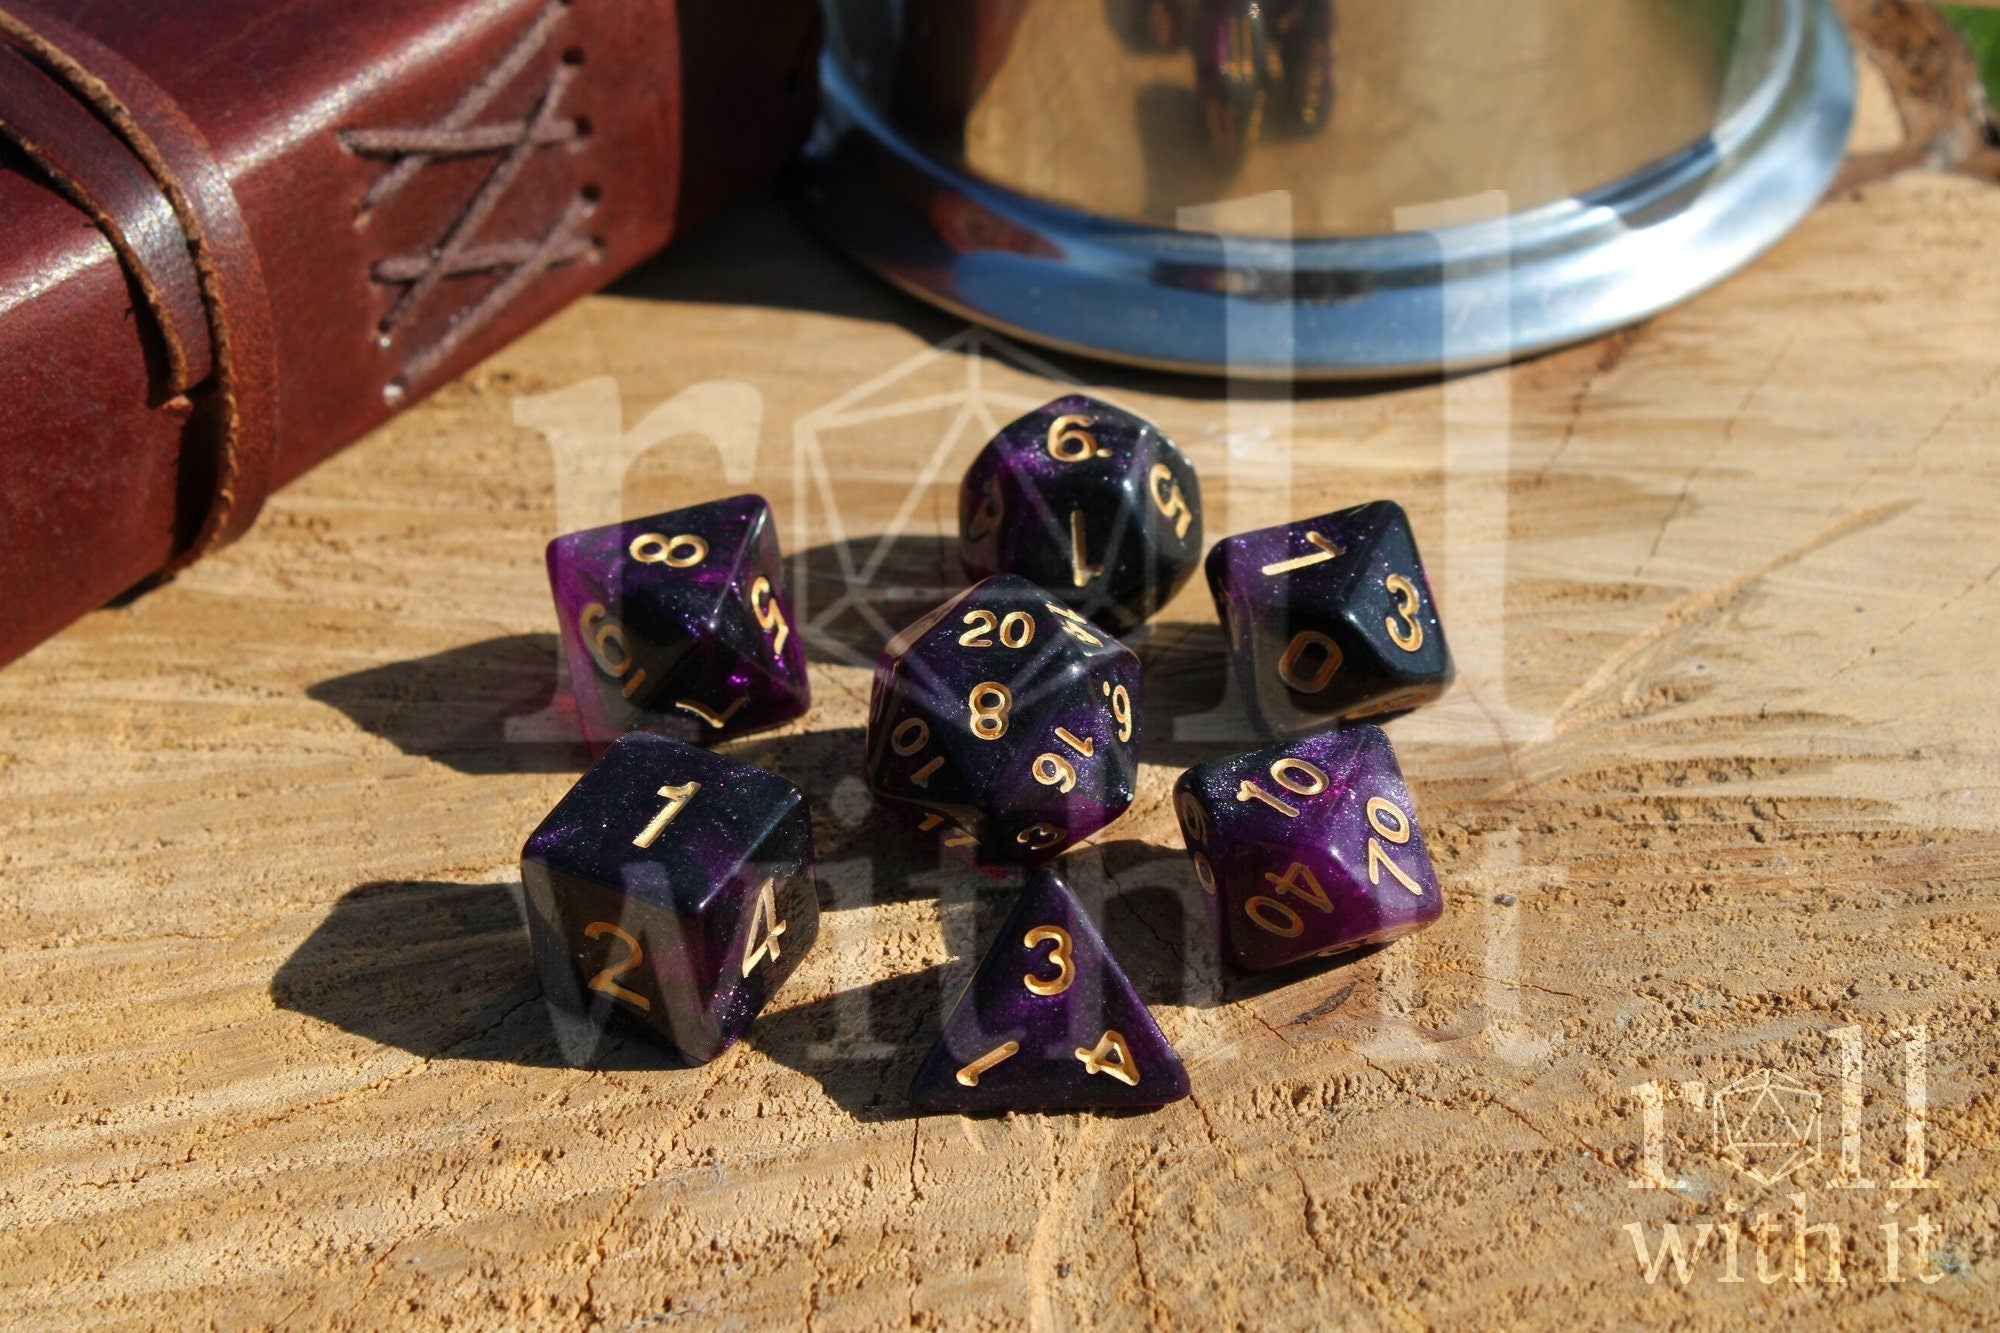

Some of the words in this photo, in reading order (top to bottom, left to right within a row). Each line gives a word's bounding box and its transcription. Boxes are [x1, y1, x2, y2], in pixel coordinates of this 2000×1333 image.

[1150, 463, 1193, 539] 5
[629, 533, 709, 568] 8
[1069, 509, 1103, 588] 1
[751, 576, 790, 655] 5
[958, 609, 1036, 649] 20
[1385, 573, 1424, 652] 3
[1278, 630, 1343, 694] 0
[969, 681, 1013, 740] 8
[891, 717, 945, 789] 10
[1032, 726, 1094, 793] 16
[1236, 757, 1330, 818] 10
[632, 780, 702, 849] 1
[1366, 796, 1424, 895] 70
[742, 877, 788, 979] 4
[1244, 861, 1335, 938] 40
[584, 920, 644, 1012] 2
[1024, 924, 1076, 996] 3
[956, 1040, 1020, 1087] 1
[1075, 1029, 1141, 1086] 4
